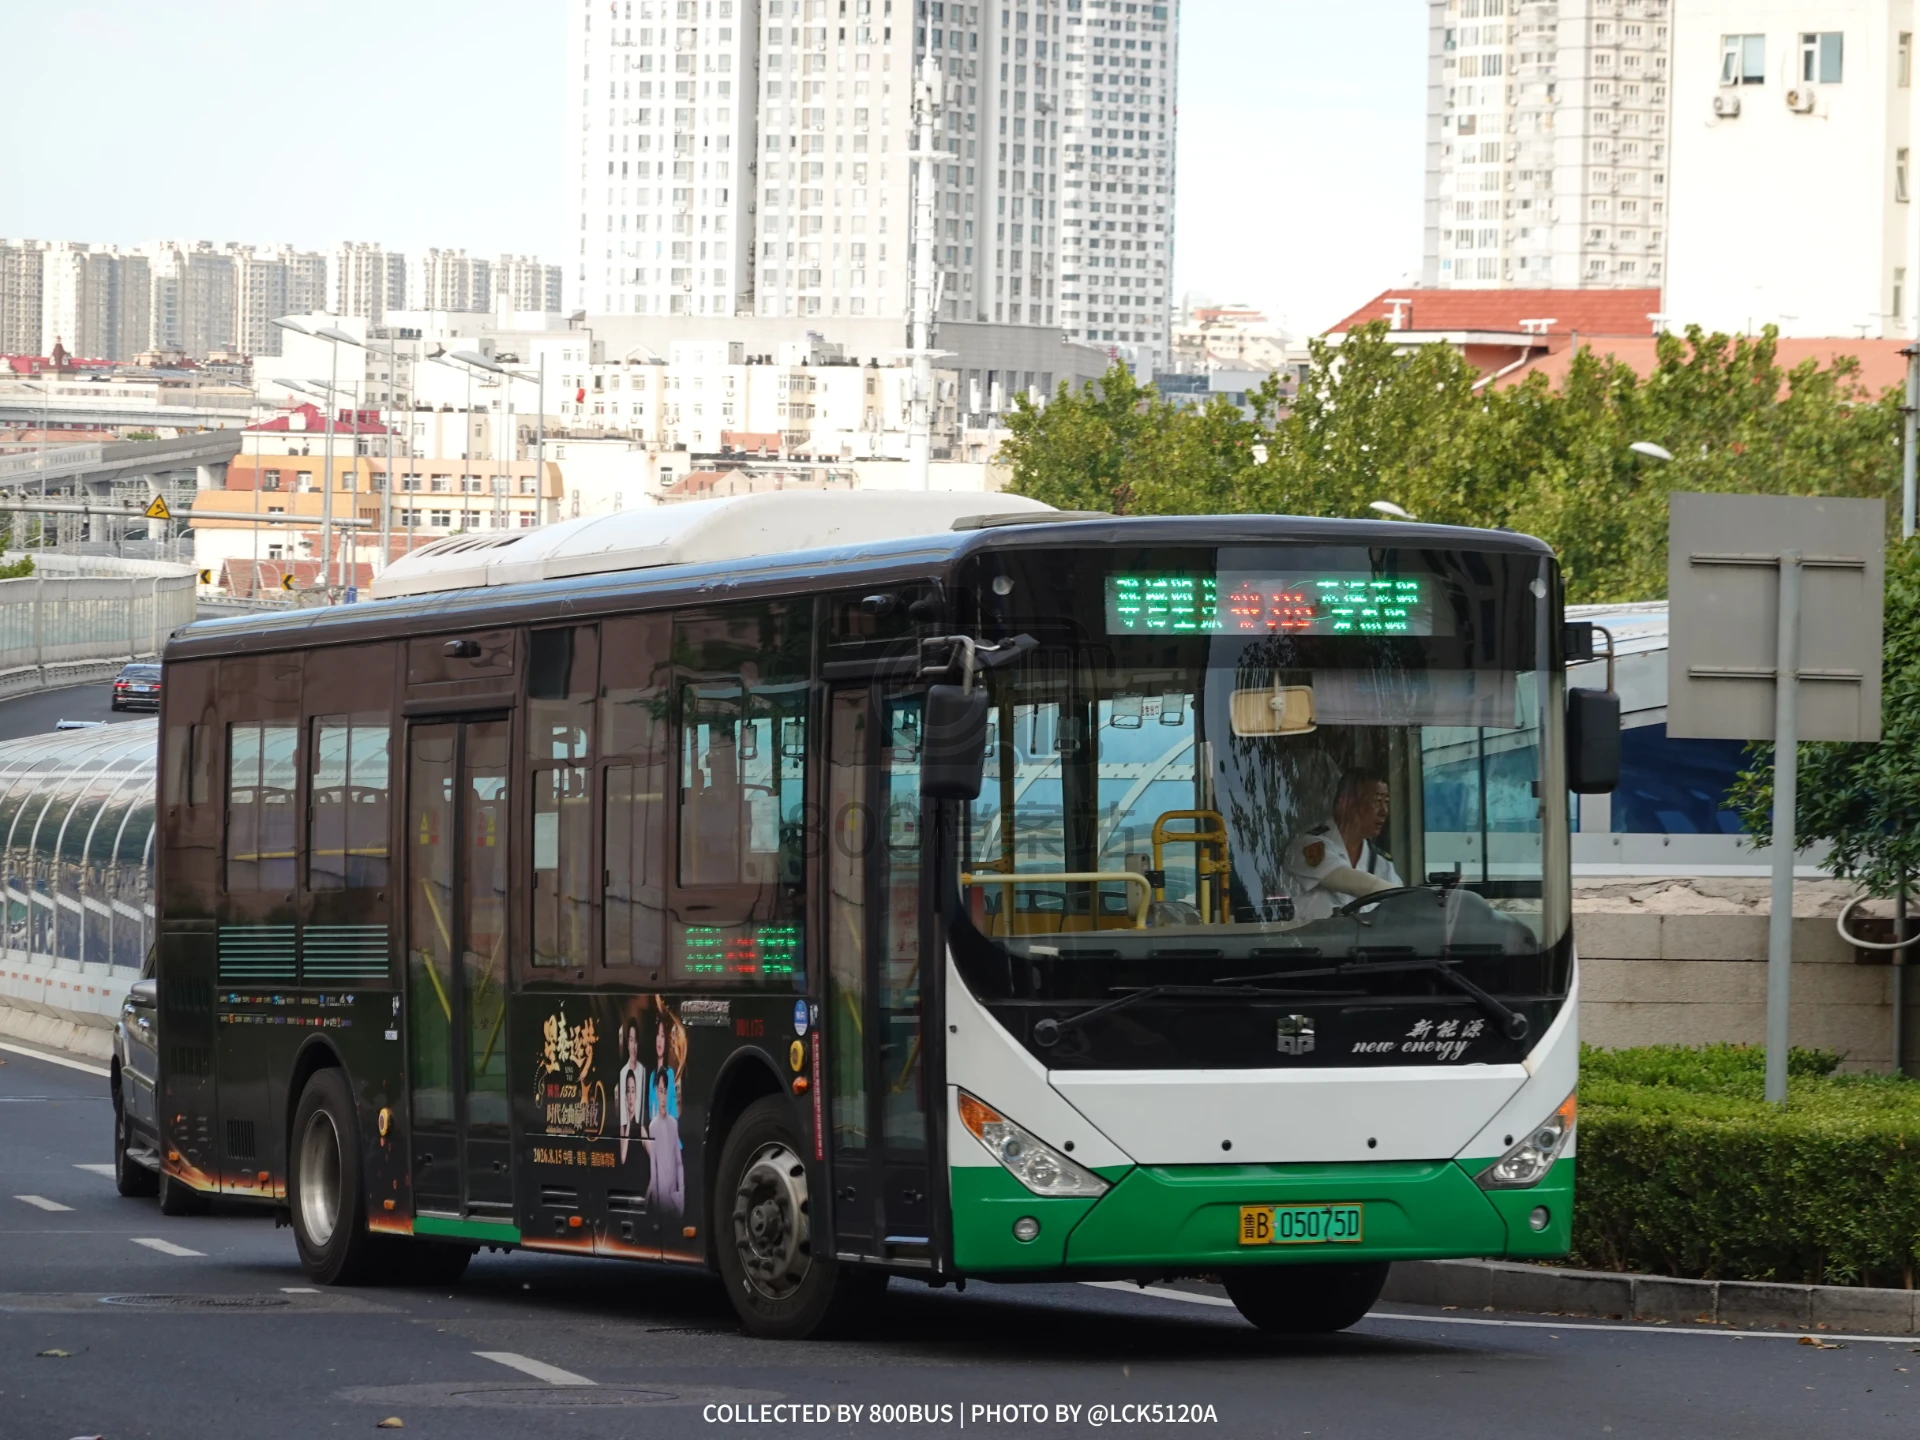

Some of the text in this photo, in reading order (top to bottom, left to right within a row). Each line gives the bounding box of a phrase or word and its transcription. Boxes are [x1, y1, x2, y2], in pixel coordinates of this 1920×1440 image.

[1405, 1018, 1485, 1040] 新能源
[1351, 1040, 1471, 1061] new energy
[1243, 1210, 1359, 1239] 鲁B 05075D
